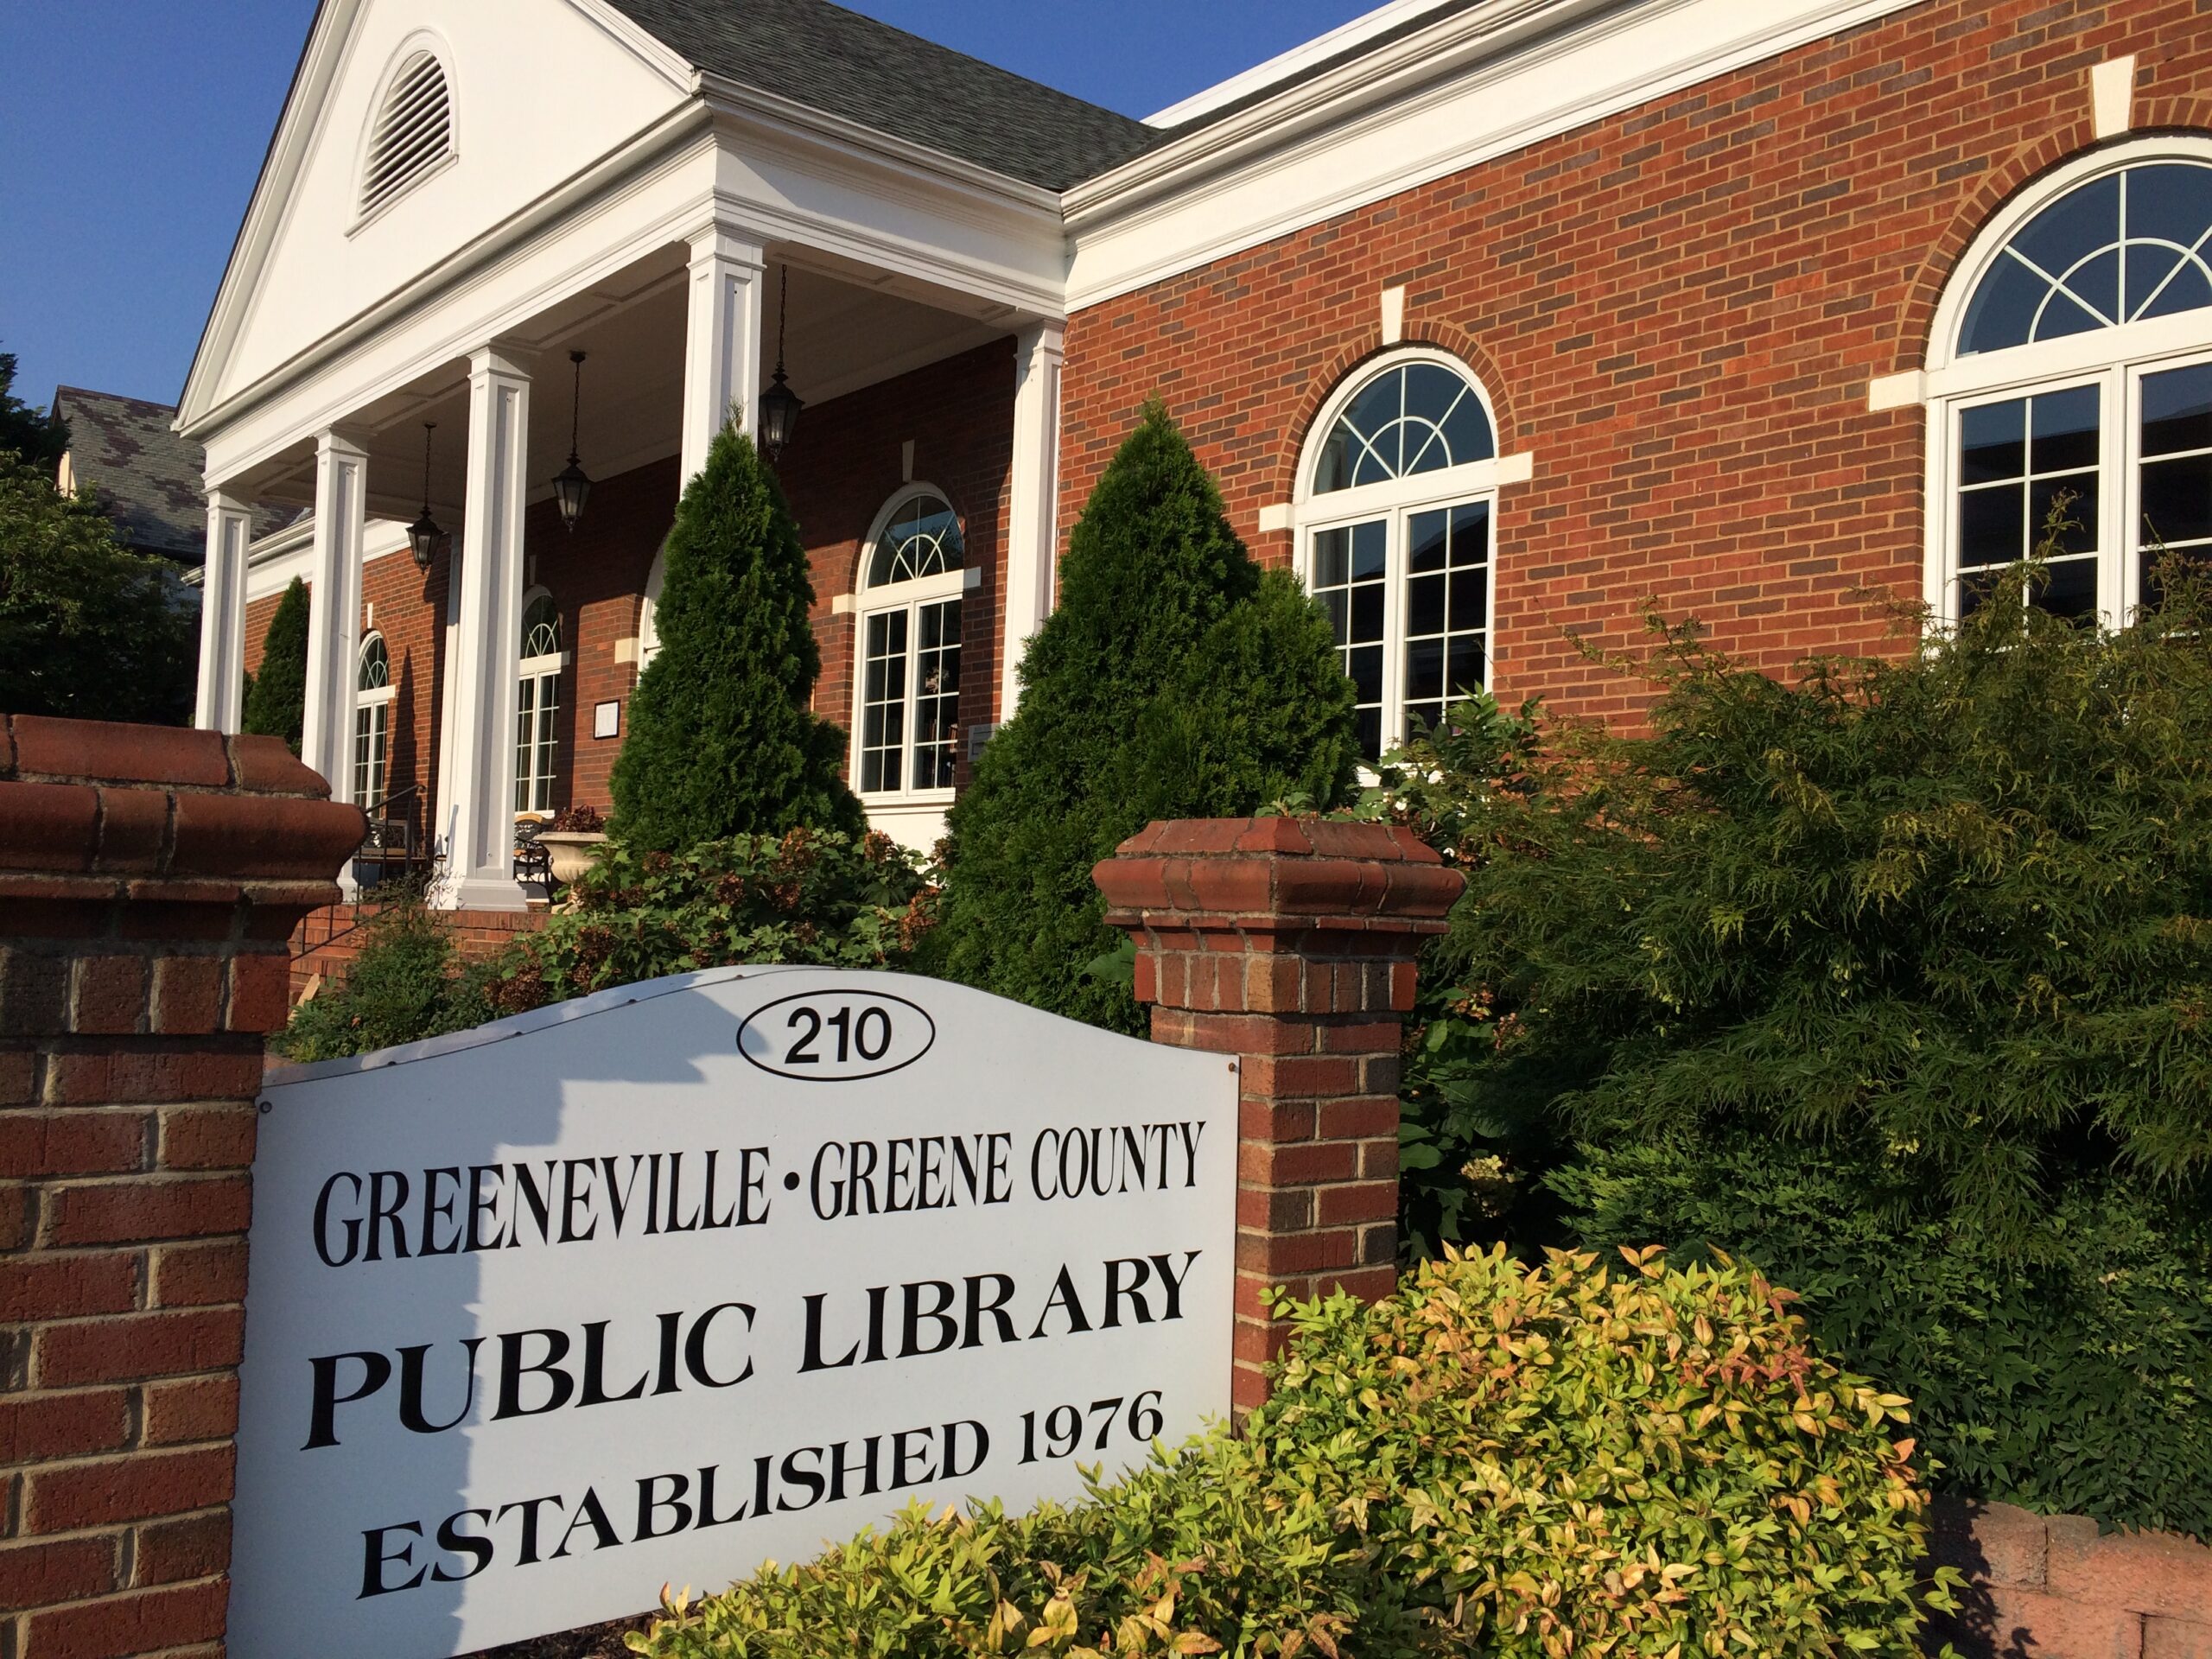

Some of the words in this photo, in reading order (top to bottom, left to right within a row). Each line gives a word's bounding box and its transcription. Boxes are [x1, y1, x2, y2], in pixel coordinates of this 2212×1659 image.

[785, 1007, 892, 1065] 210
[1031, 1122, 1206, 1200] COUNTY
[300, 1302, 757, 1452] PUBLIC
[797, 1249, 1203, 1374] LIBRARY
[355, 1419, 990, 1601] ESTABLISHED
[1018, 1390, 1164, 1465] 1976
